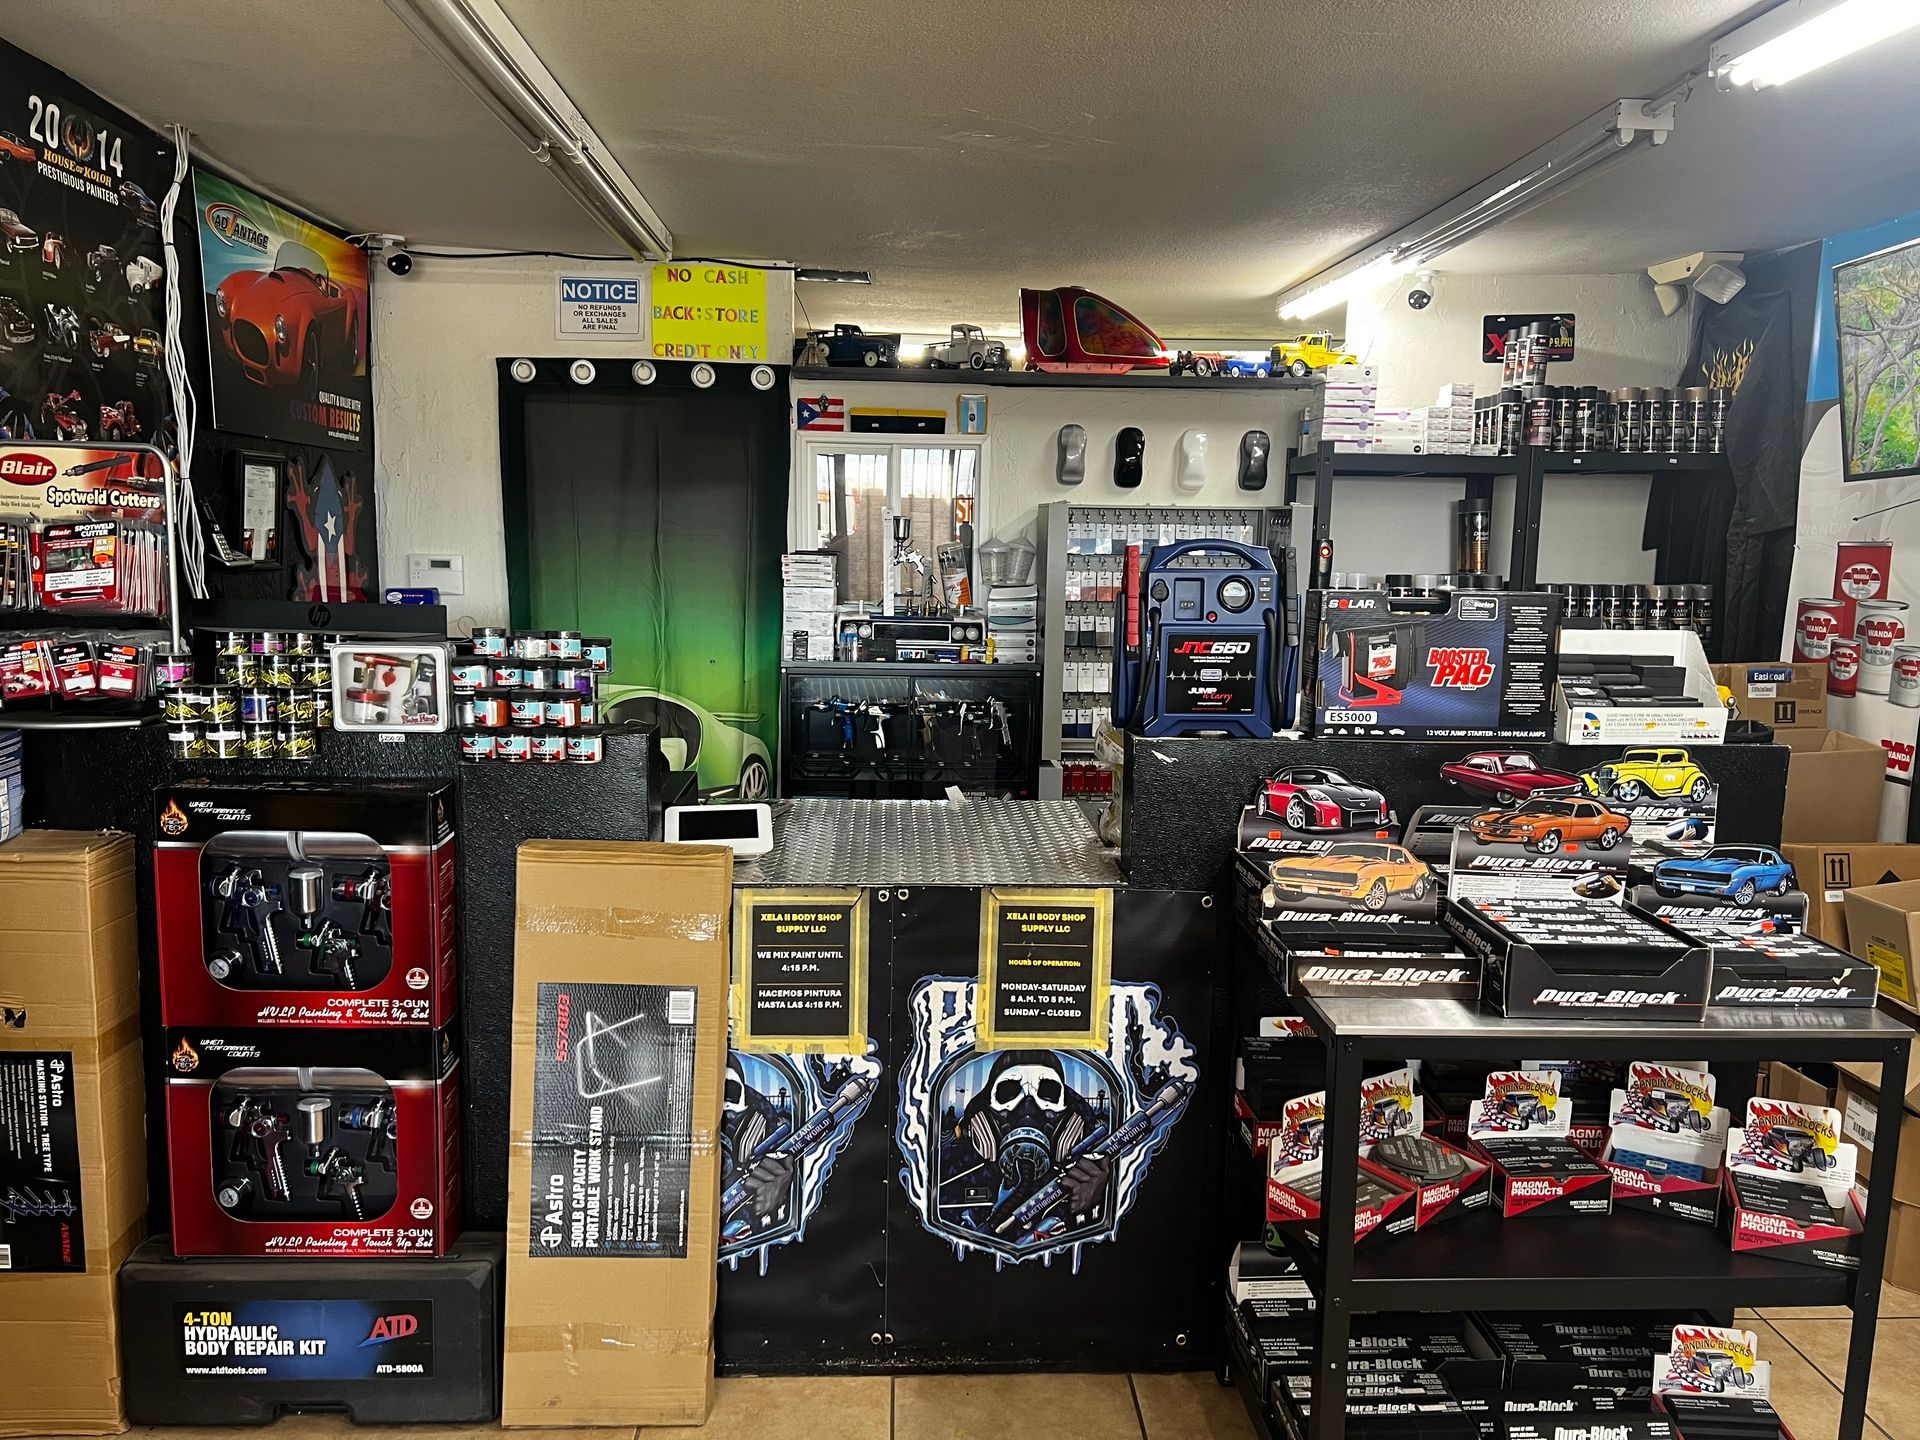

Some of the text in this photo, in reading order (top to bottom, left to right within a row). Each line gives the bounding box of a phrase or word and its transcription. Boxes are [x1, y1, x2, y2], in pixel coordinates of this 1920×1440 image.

[43, 147, 76, 173] HOUSE
[84, 166, 112, 188] KOLOR
[37, 160, 119, 206] PRESTIGIOUS PAINTERS
[667, 268, 749, 285] NO CASH
[562, 283, 637, 301] NOTICE
[589, 304, 622, 312] REFUNDS
[596, 317, 618, 325] SALES
[652, 343, 759, 360] CREDIT ONLY
[329, 407, 361, 433] RESULTS
[1, 460, 53, 476] Blair
[47, 486, 108, 507] Spotweld
[110, 490, 160, 508] Cutters
[74, 522, 115, 532] SPOTWELD
[311, 605, 329, 626] hp
[1806, 625, 1827, 633] WANDA
[1867, 630, 1893, 638] WANDA
[899, 651, 913, 659] AMC
[1173, 641, 1251, 654] JNC660
[1429, 649, 1488, 665] BOOSTER
[1433, 664, 1494, 686] PAC
[1210, 692, 1233, 703] Carry
[1330, 712, 1372, 722] ES5000
[193, 807, 247, 815] PERFORMANCE
[1471, 855, 1598, 870] Dura-Block
[760, 913, 842, 922] XELA II BODY SHOP
[1006, 912, 1029, 920] XELA
[1036, 913, 1060, 921] BODY
[1061, 913, 1087, 922] SHOP
[1277, 910, 1405, 924] Dura-Block
[1655, 904, 1767, 919] Dura-Block
[776, 925, 827, 933] SUPPLY LLC
[1021, 924, 1071, 933] SUPPLY LLC
[1444, 911, 1493, 953] Dura-Block
[757, 951, 844, 959] WE MIX PAINT UNTIL
[781, 964, 820, 972] 4:15 P.M.
[1301, 966, 1470, 982] Dura-Block
[758, 989, 842, 998] HACEMOS PINTURA
[1001, 983, 1087, 992] MONDAY-SATURDAY
[1717, 985, 1852, 1000] Dura-Block
[327, 998, 429, 1008] COMPLETE 3-GUN
[757, 1001, 843, 1009] HASTA LAS 4:15 P.M.
[1010, 995, 1016, 1003] 8
[1017, 995, 1037, 1003] A.M.
[1038, 995, 1050, 1003] TO
[1057, 996, 1076, 1004] P.M.
[1535, 988, 1680, 1006] Dura-Block
[256, 1006, 295, 1018] HVLP
[298, 1006, 343, 1021] Painting
[345, 1008, 354, 1018] &
[356, 1007, 388, 1019] Touch
[390, 1008, 408, 1022] Up
[410, 1008, 430, 1019] Set
[1003, 1008, 1040, 1016] SUNDAY
[1046, 1009, 1082, 1017] CLOSED
[51, 1073, 64, 1107] Astro
[1633, 1078, 1709, 1101] SANDING BLOCKS
[36, 1059, 53, 1173] MASKING STATION TREE TYPE
[789, 1121, 815, 1145] FLAKE
[1106, 1123, 1132, 1145] FLAKE
[1751, 1115, 1834, 1139] SANDING BLOCKS
[789, 1117, 832, 1154] THE WORLD!
[1105, 1120, 1149, 1155] THE WORLD!
[585, 1105, 603, 1248] PORTABLE WORK STAND
[1512, 1180, 1549, 1189] MAGNA
[571, 1149, 587, 1248] 500LB CAPACITY
[1269, 1185, 1296, 1205] MAGNA
[1422, 1184, 1450, 1199] MAGNA
[1422, 1187, 1460, 1207] PRODUCTS
[1511, 1187, 1564, 1196] PRODUCTS
[545, 1174, 564, 1226] Astro
[1020, 1189, 1063, 1223] FLAKETHROWER
[1269, 1193, 1307, 1219] PRODUCTS
[1741, 1212, 1787, 1229] MAGNA
[333, 1228, 433, 1238] COMPLETE 3-GUN
[1740, 1220, 1806, 1240] PRODUCTS
[183, 1311, 232, 1327] 4-TON
[369, 1314, 419, 1340] ATD
[184, 1325, 278, 1341] HYDRAULIC
[1555, 1324, 1634, 1336] Dura-Block
[185, 1340, 326, 1356] BODY REPAIR KIT
[1677, 1337, 1752, 1357] SANDING BLOCKS
[186, 1366, 267, 1375] www.atdtools.com
[376, 1364, 424, 1374] ATD-5800A
